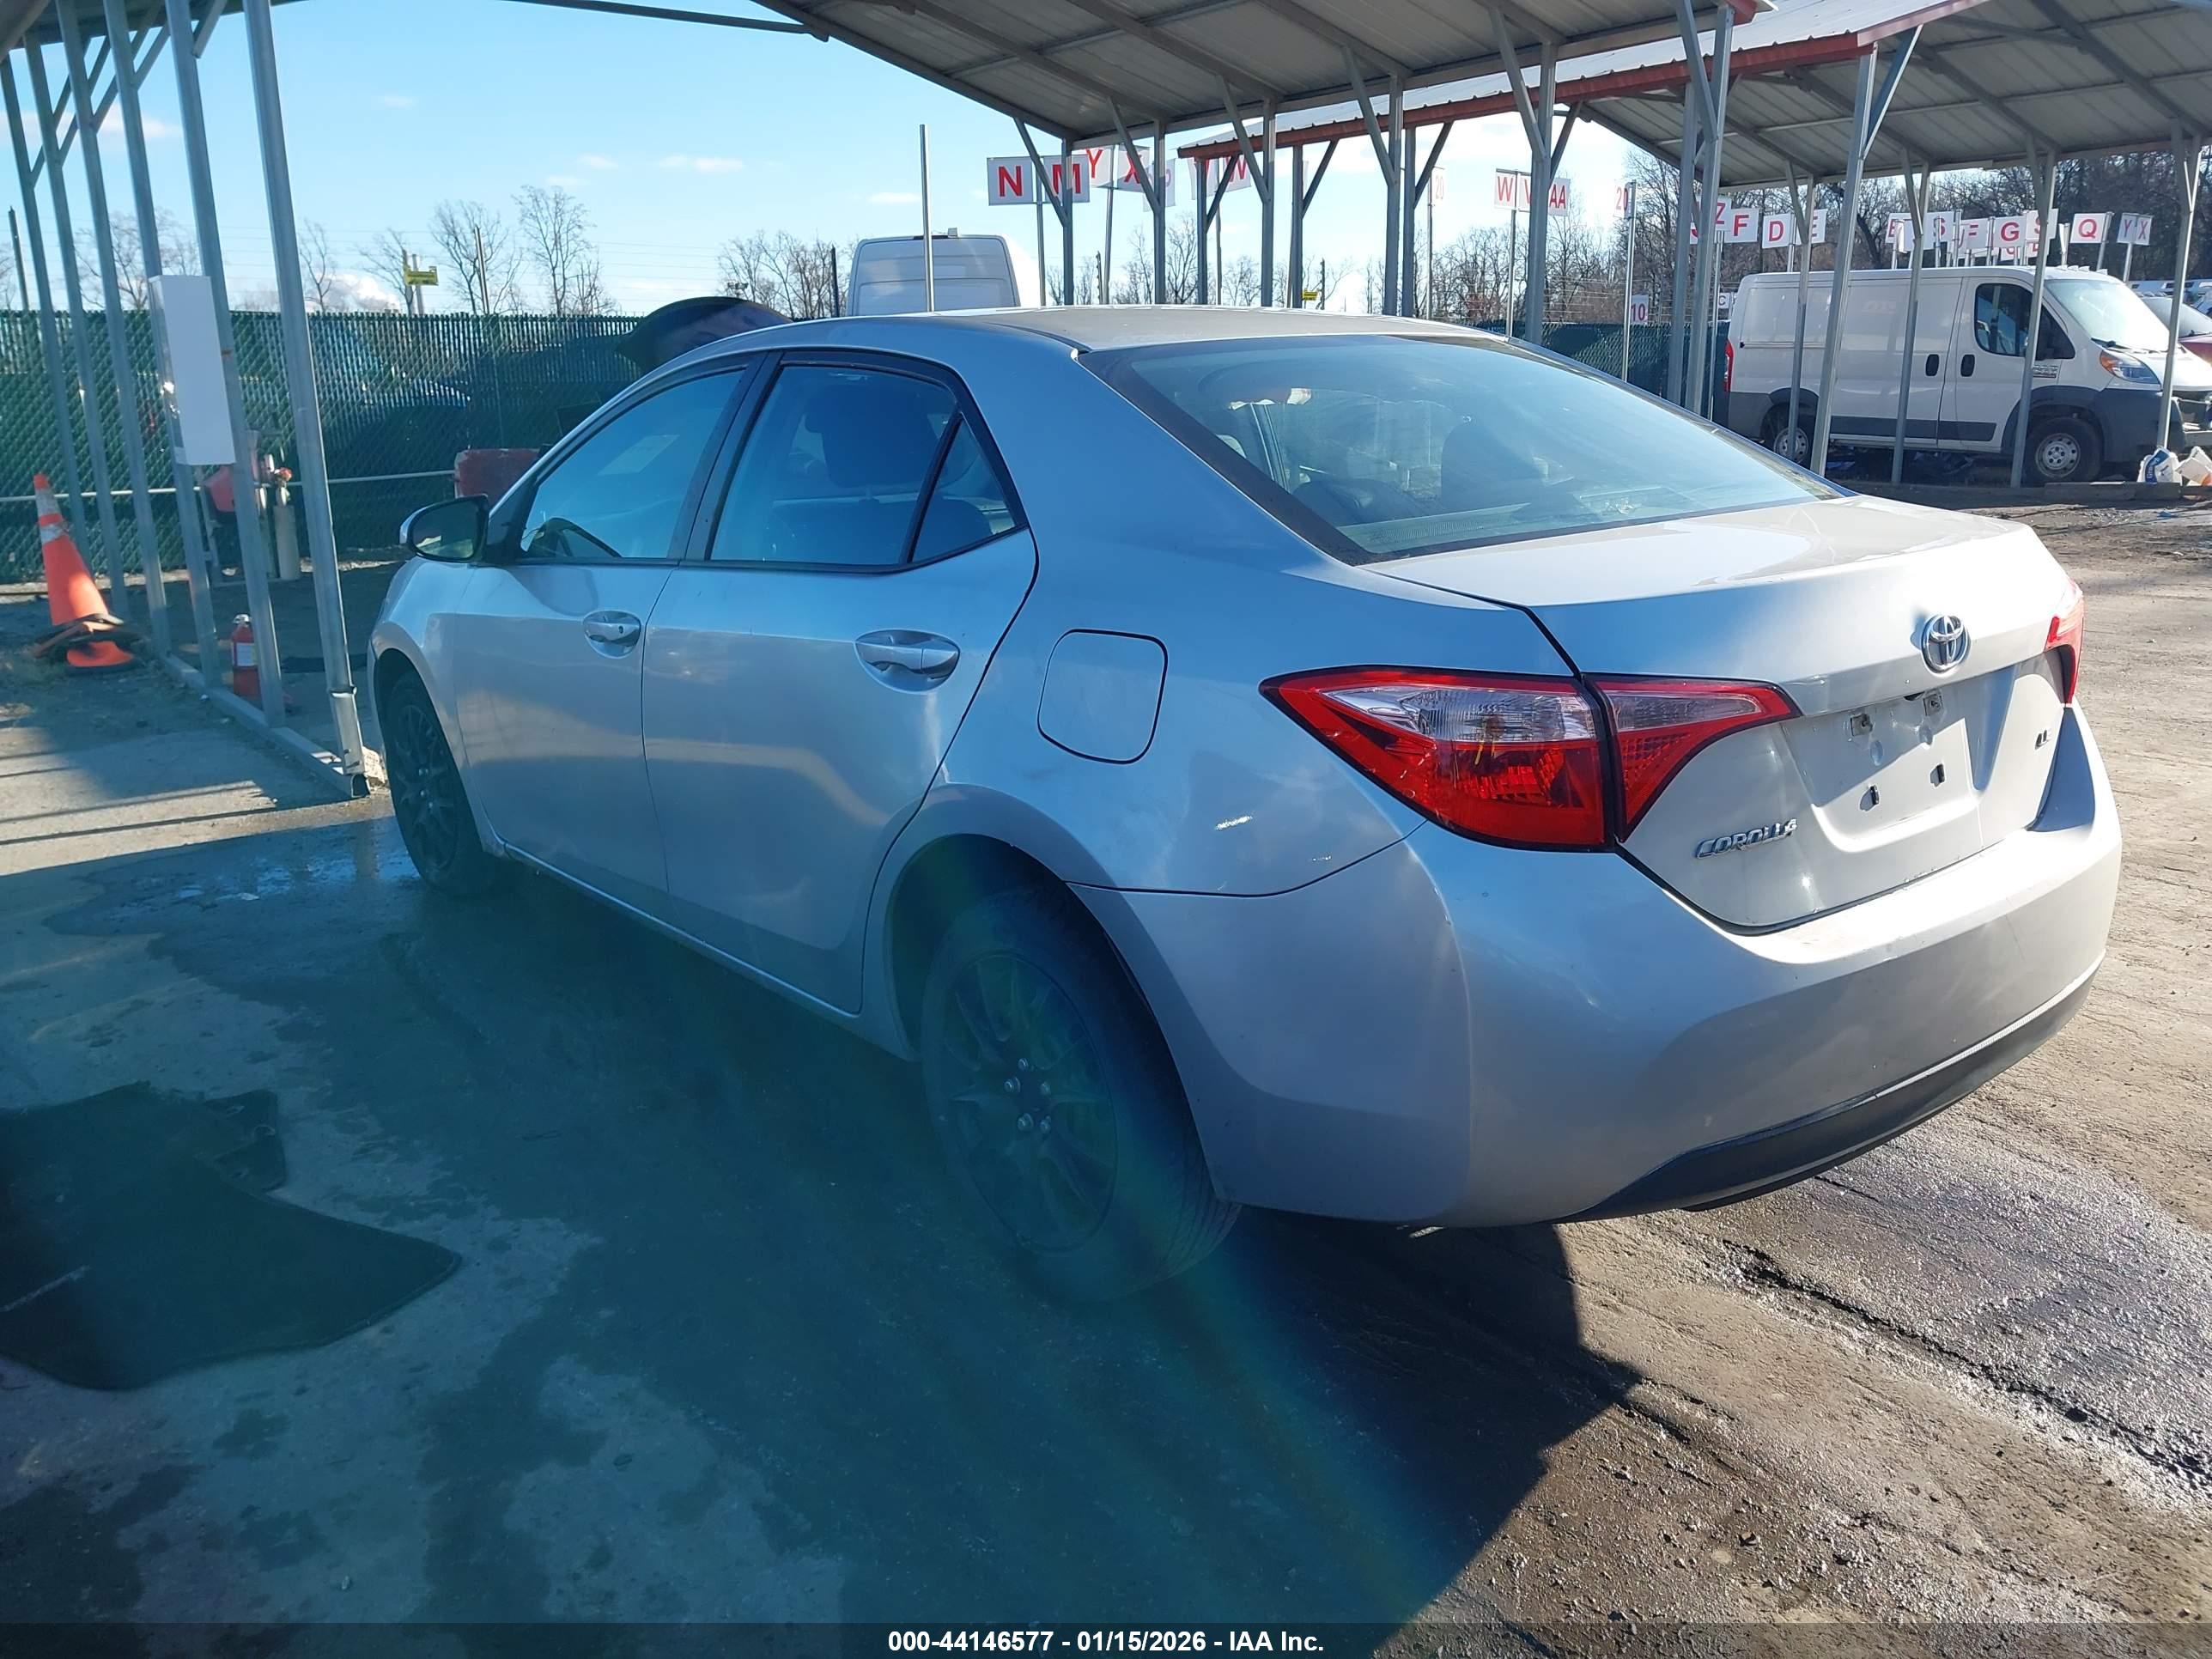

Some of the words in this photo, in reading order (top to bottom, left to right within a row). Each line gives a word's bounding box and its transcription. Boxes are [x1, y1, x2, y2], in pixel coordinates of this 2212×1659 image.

[998, 165, 1023, 197] N
[1497, 176, 1514, 202] W
[1549, 184, 1566, 209] AA
[1733, 215, 1750, 237] F
[1768, 220, 1784, 241] D
[2001, 222, 2020, 241] G
[2078, 218, 2098, 239] Q
[2123, 219, 2132, 238] Y
[2138, 220, 2148, 240] X
[1631, 303, 1646, 321] 10
[1696, 818, 1797, 859] COROLLA
